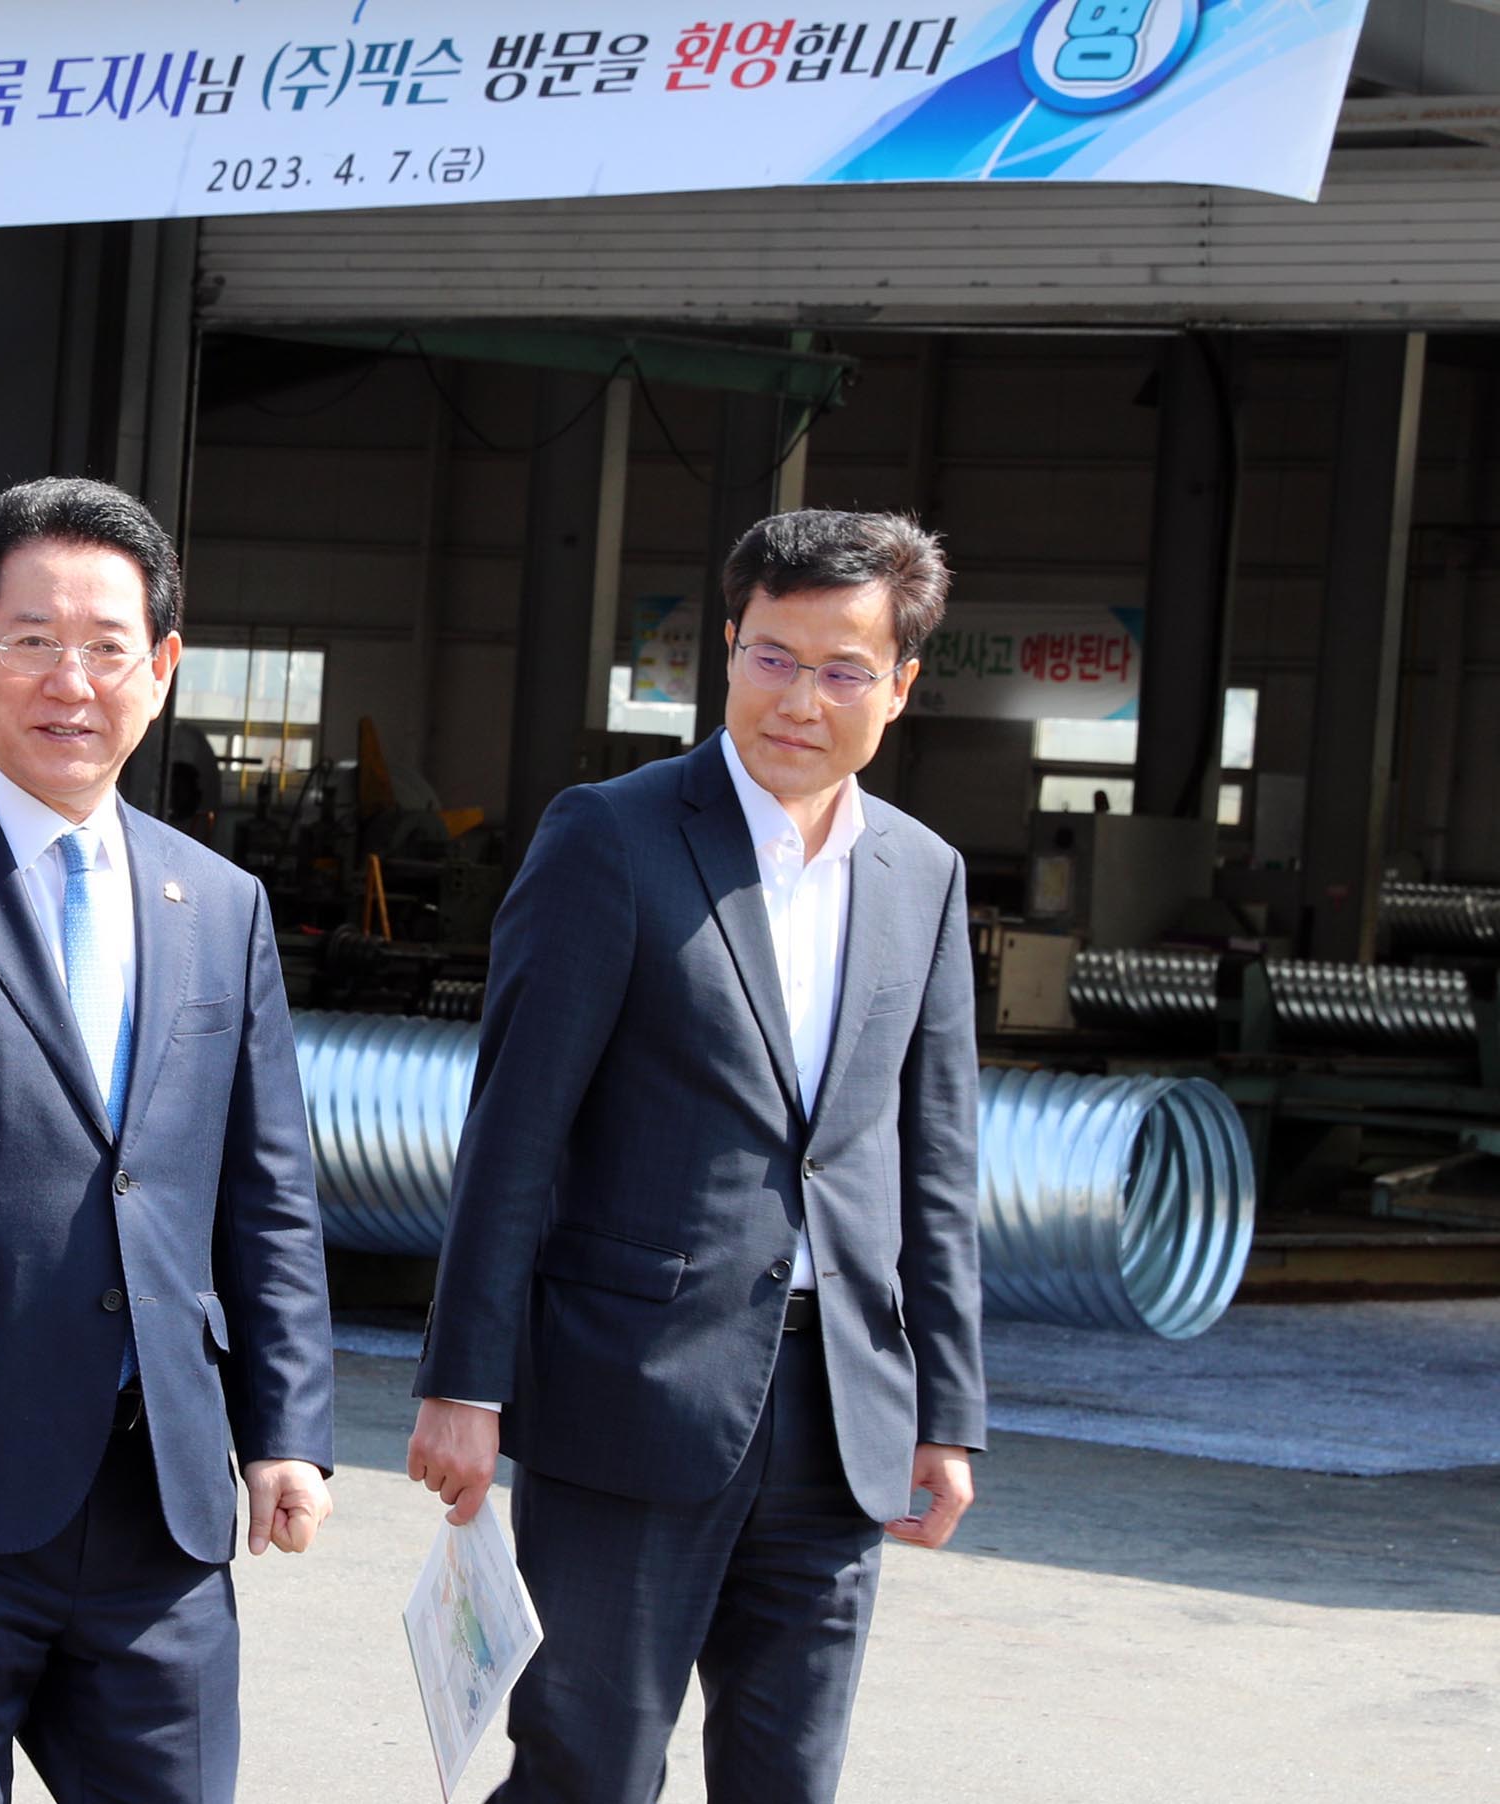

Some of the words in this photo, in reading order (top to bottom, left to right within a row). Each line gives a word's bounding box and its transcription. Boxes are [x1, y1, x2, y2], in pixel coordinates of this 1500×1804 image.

[36, 50, 246, 121] 도지사님
[261, 38, 464, 111] (주)픽슨
[484, 30, 650, 102] 방문을
[664, 16, 957, 92] 환영합니다
[206, 155, 312, 192] 2023.
[333, 153, 365, 186] 4.
[1020, 632, 1133, 683] 예방된다
